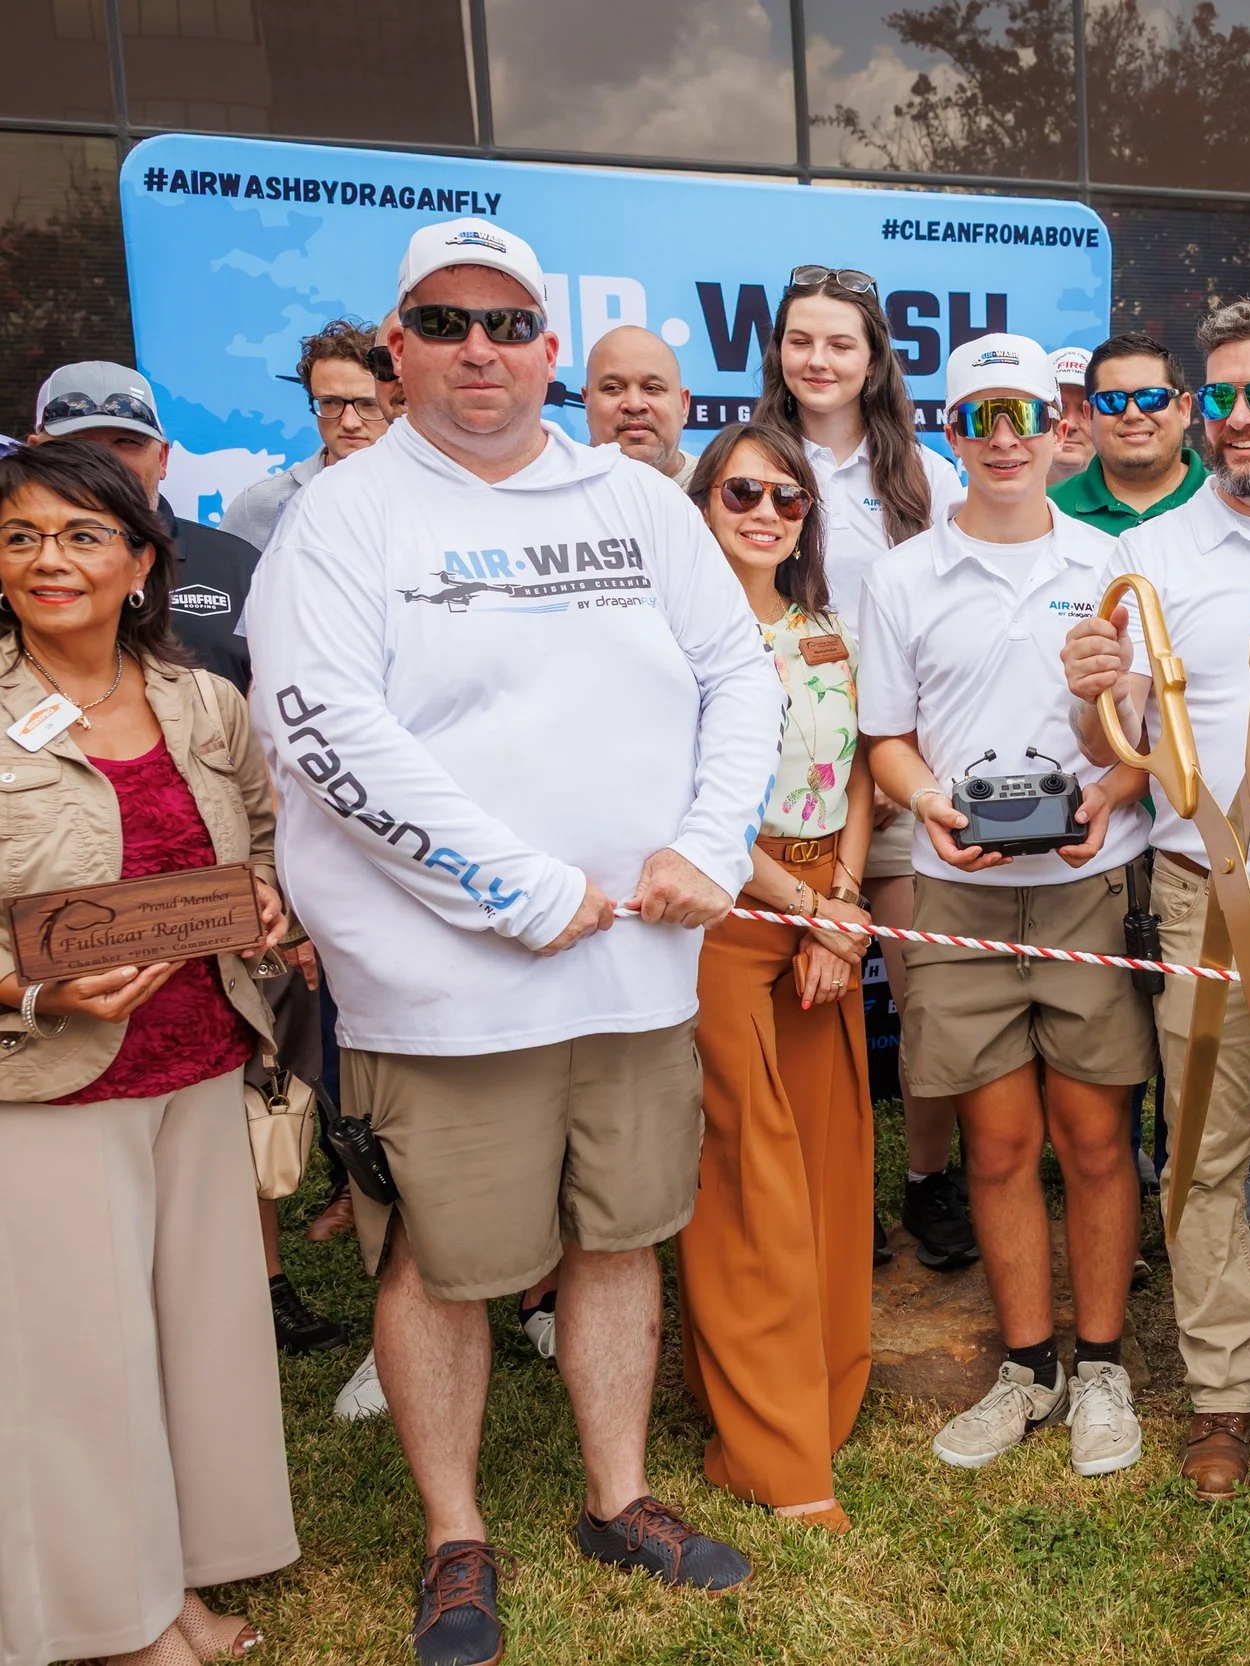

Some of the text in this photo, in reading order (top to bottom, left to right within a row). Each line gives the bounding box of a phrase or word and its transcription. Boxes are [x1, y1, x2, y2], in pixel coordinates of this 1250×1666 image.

[143, 167, 502, 216] #AIRWASHBYDRAGANFLY
[882, 218, 1099, 248] #CLEANFROMABOVE
[695, 281, 1008, 377] WSH
[1057, 361, 1087, 371] FIRE
[444, 537, 644, 579] AIR WASH
[524, 578, 650, 596] HEIGHTS CLEANIN
[171, 594, 227, 607] SURFACE
[577, 600, 590, 610] BY
[1049, 600, 1070, 610] AIR
[138, 889, 231, 914] Proud Member
[60, 907, 235, 953] Fulshear Regional
[172, 936, 233, 951] Commerce
